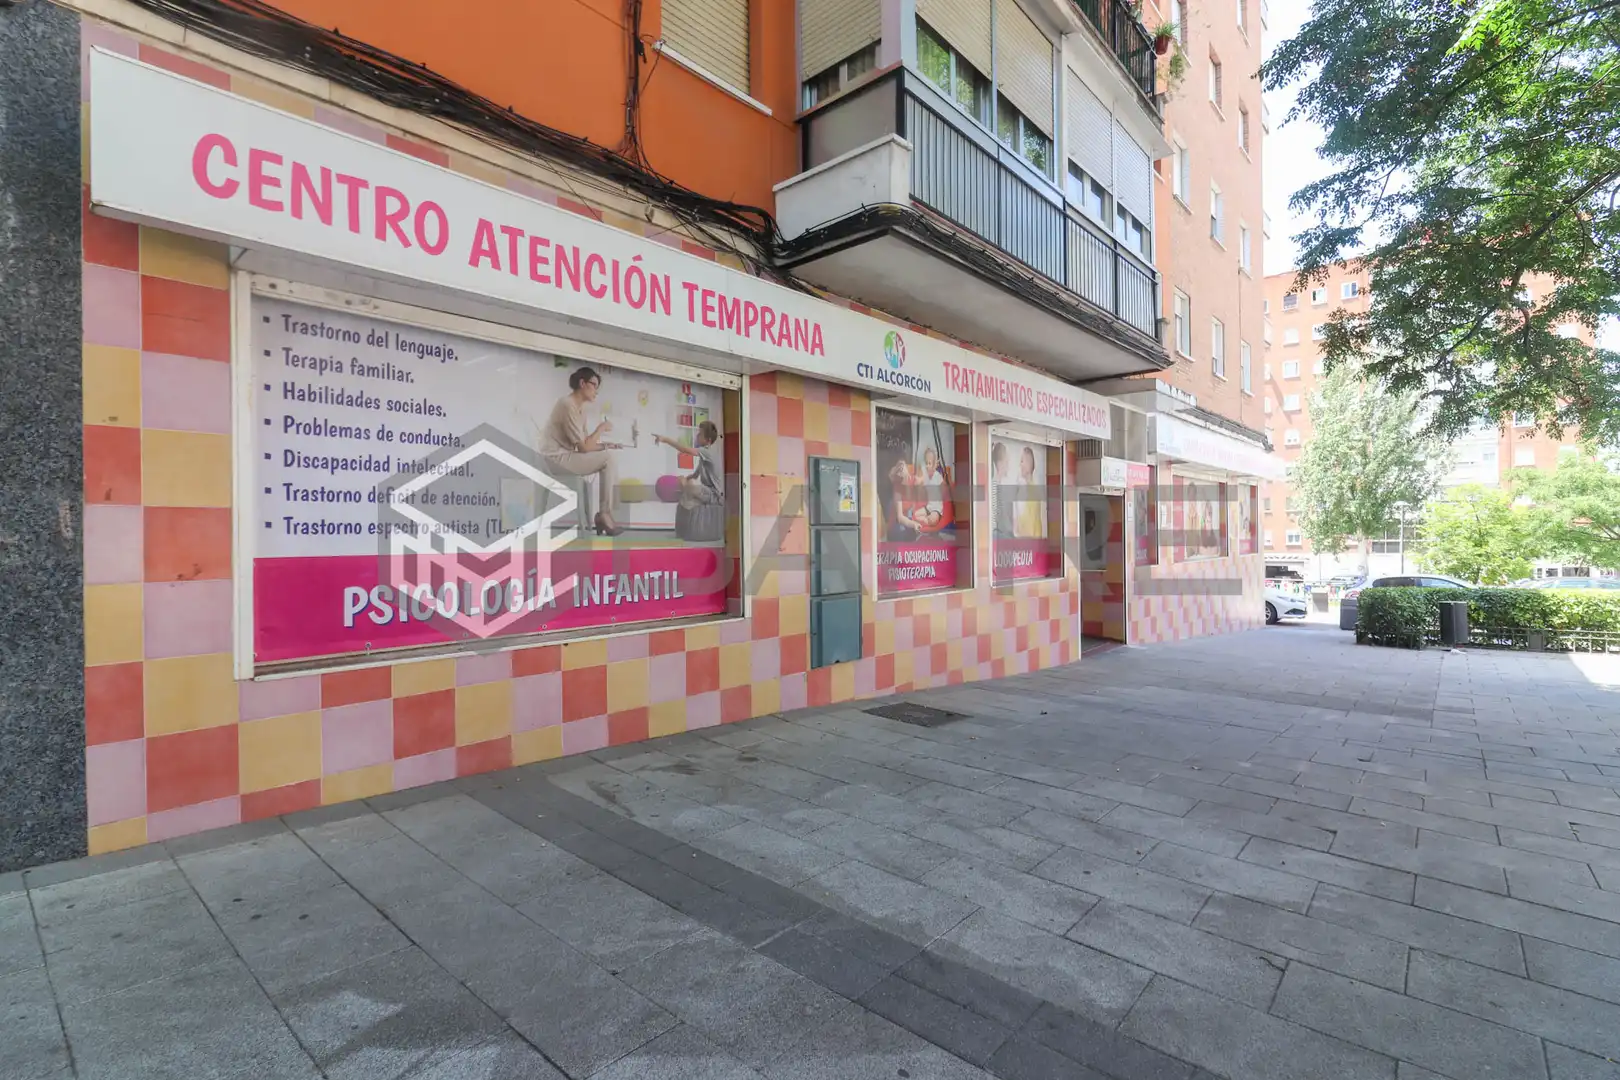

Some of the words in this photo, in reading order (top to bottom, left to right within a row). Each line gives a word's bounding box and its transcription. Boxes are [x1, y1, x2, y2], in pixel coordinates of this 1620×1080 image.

[191, 133, 450, 256] CENTRO
[468, 217, 672, 316] ATENCIÓN
[682, 281, 825, 357] TEMPRANA
[281, 313, 361, 344] Trastorno
[366, 329, 389, 350] del
[395, 333, 459, 362] lenguaje.
[282, 347, 343, 376] Terapia
[350, 358, 414, 384] familiar.
[857, 362, 873, 379] CTI
[877, 367, 931, 393] ALCORCÓN
[283, 381, 381, 410] Habilidades
[386, 398, 447, 418] sociales.
[942, 361, 1033, 410] TRATAMIENTOS
[1036, 391, 1107, 429] ESPECIALIZADOS
[283, 415, 371, 441] Problemas
[376, 424, 394, 442] de
[400, 428, 466, 448] conducta.
[283, 449, 391, 475] Discapacidad
[396, 458, 474, 478] intelectual.
[283, 483, 362, 504] Trastorno
[421, 488, 438, 505] de
[442, 490, 500, 507] atención.
[283, 517, 362, 536] Trastorno
[367, 519, 430, 540] espectro
[434, 519, 479, 536] autista
[888, 565, 936, 581] FISIOTERAPIA
[904, 549, 950, 564] OCUPACIONAL
[343, 568, 556, 627] PSICOLOGÍA
[573, 570, 685, 608] INFANTIL
